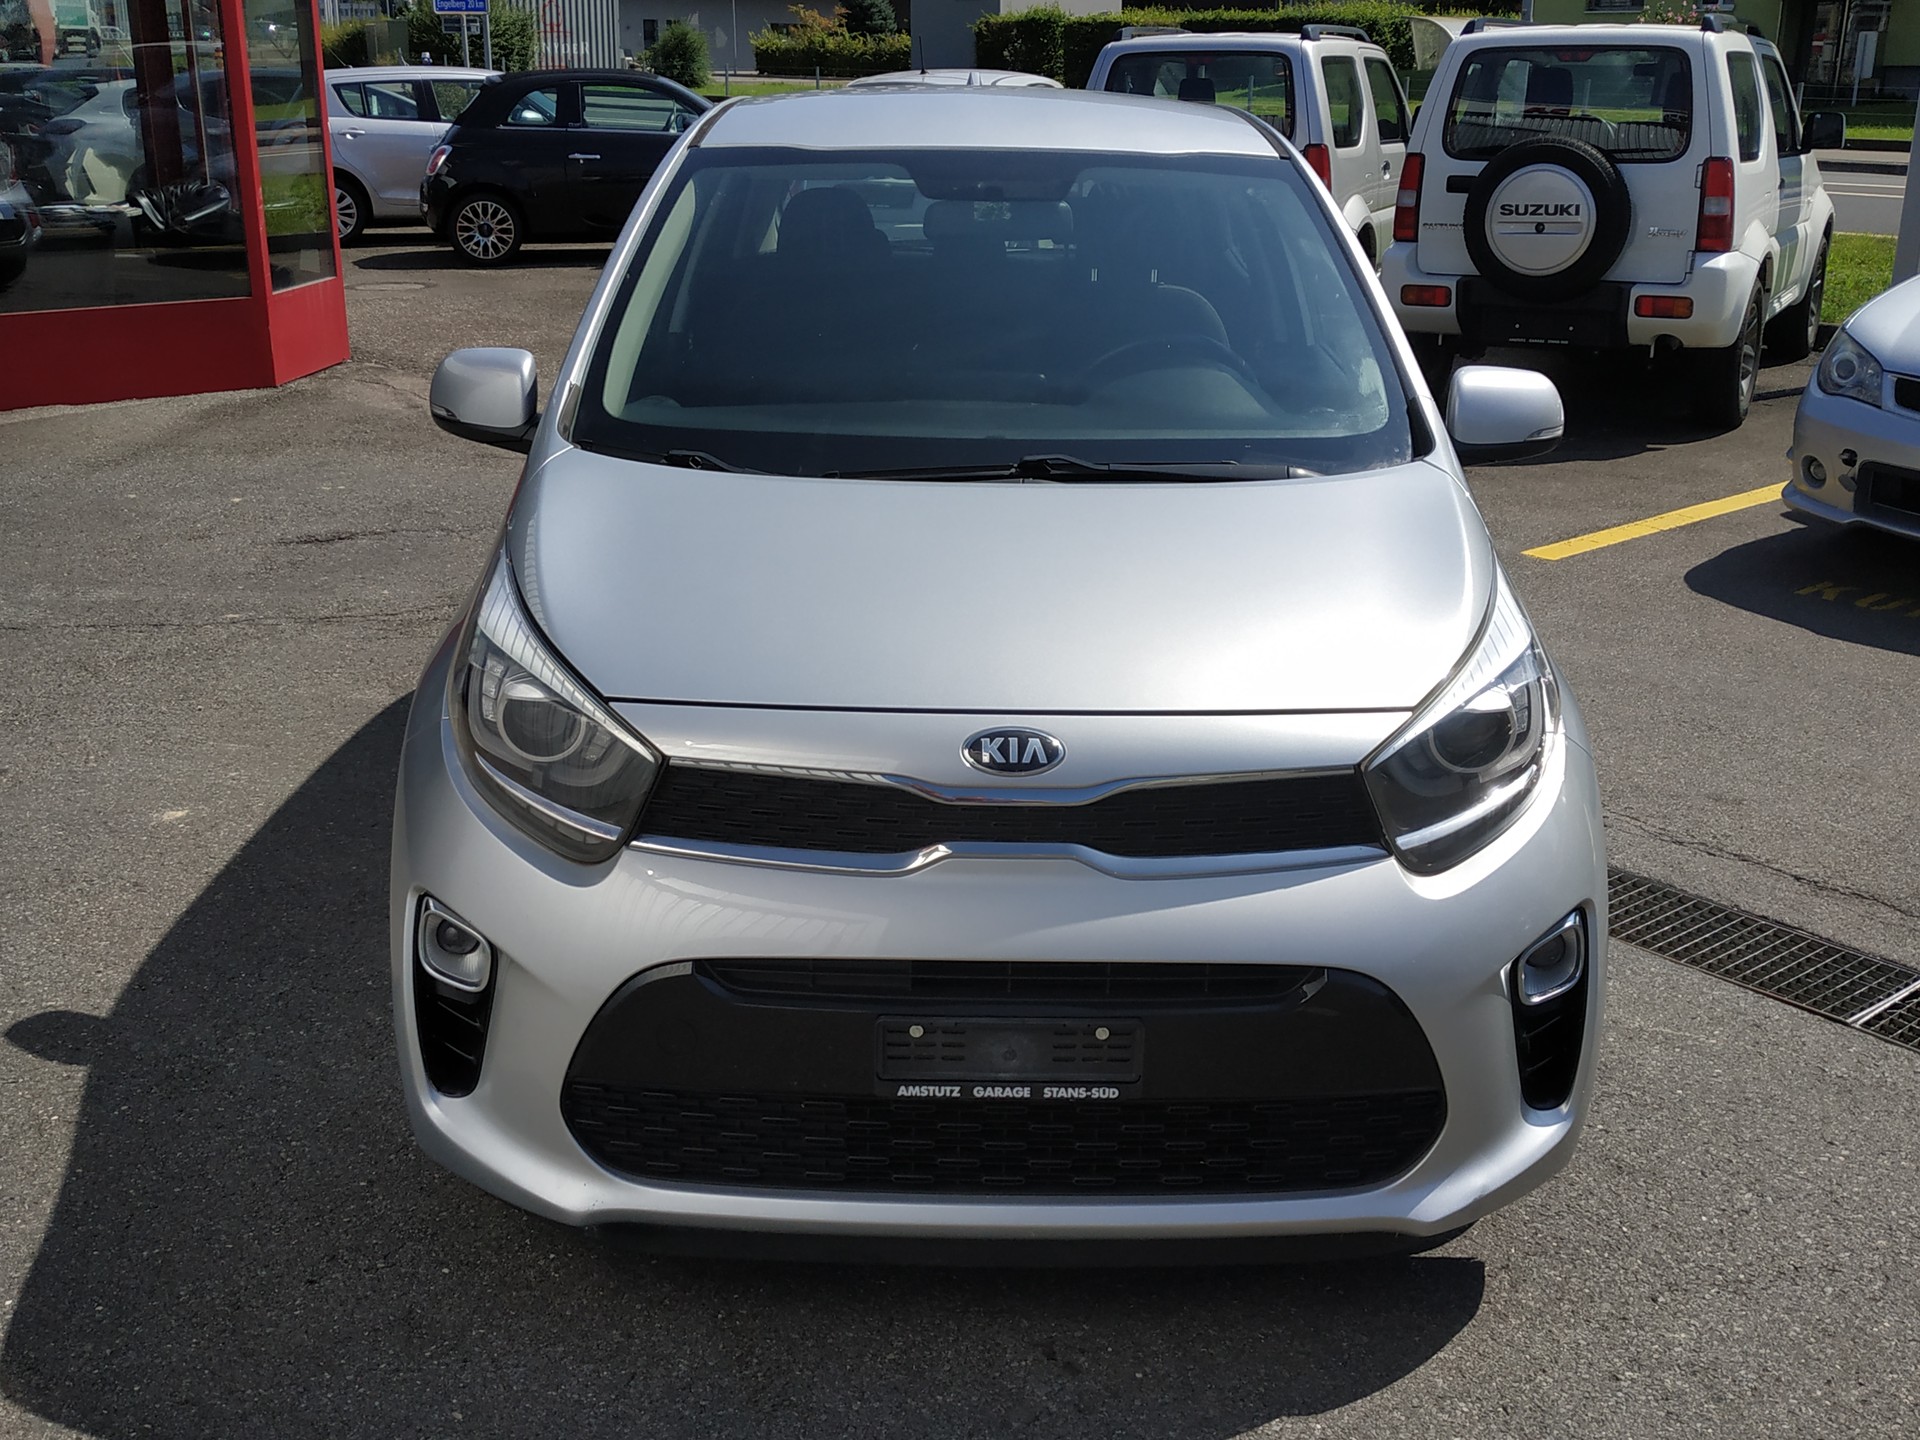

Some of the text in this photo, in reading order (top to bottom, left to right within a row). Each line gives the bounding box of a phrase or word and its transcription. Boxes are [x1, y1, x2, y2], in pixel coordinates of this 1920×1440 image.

[437, 0, 485, 10] Engelberg 20 km
[1500, 203, 1580, 217] SUZUKI
[980, 737, 1048, 764] KIA
[896, 1085, 1120, 1099] AMSTUTZ GARAGE STANS-SÜD
